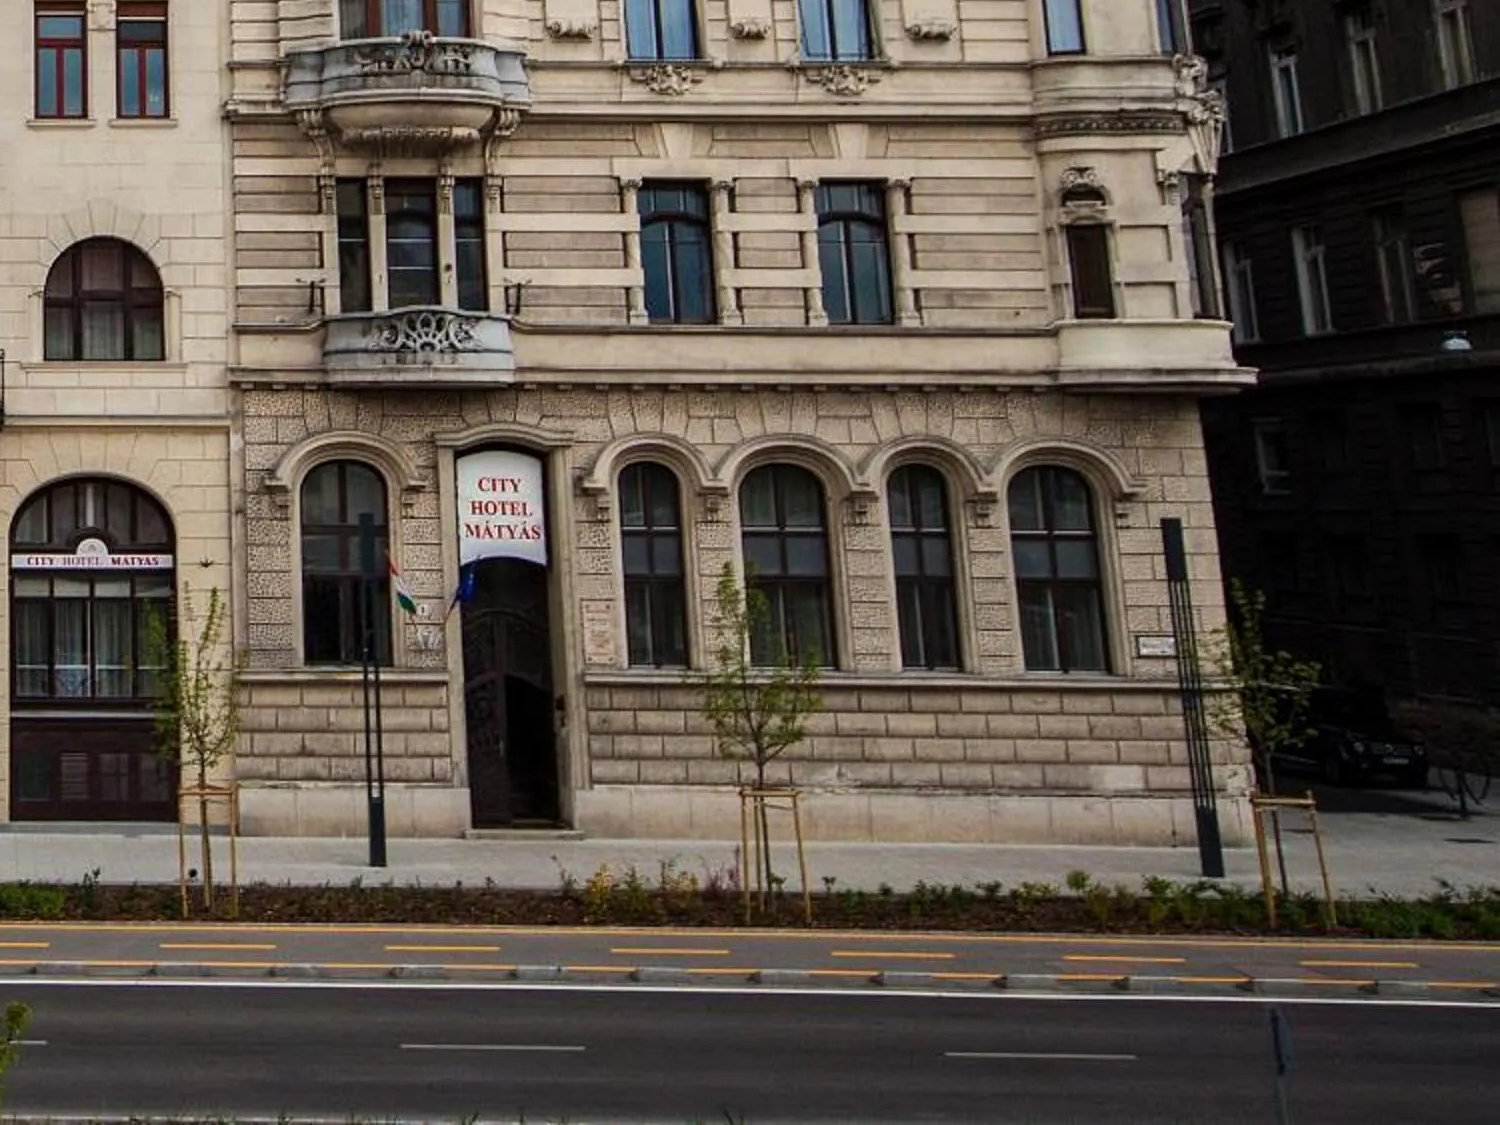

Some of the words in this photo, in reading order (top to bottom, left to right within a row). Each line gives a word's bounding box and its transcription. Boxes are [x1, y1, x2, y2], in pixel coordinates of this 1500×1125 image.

[477, 476, 522, 493] CITY
[468, 500, 533, 516] HOTEL
[464, 520, 541, 540] MÁTYÁS
[27, 556, 54, 566] CITY
[63, 556, 100, 566] HOTEL
